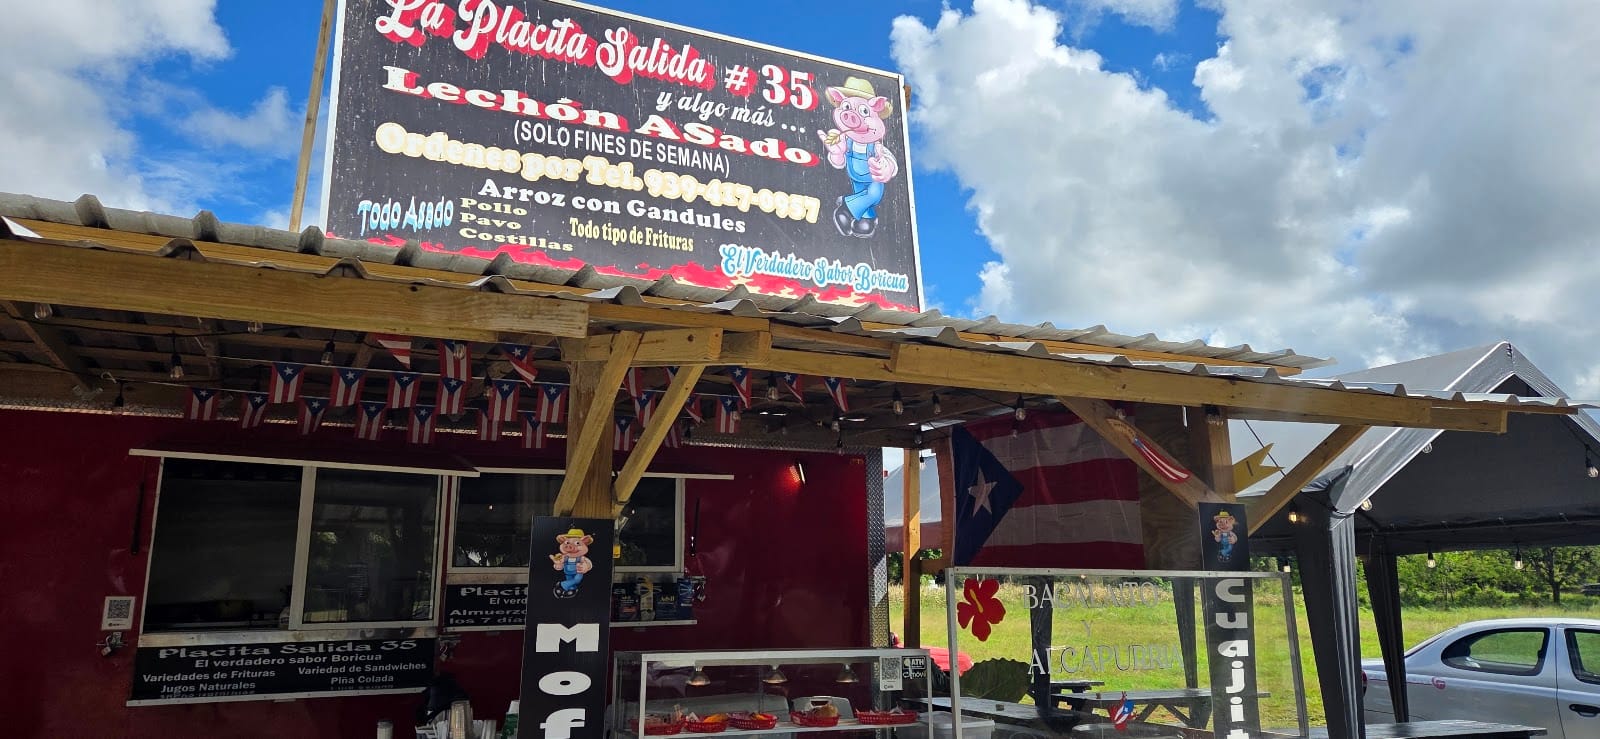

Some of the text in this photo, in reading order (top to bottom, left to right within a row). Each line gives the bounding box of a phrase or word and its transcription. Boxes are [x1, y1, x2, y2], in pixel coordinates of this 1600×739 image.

[376, 0, 813, 110] La Placita Salida # 35
[382, 65, 621, 130] Lechón
[656, 91, 672, 111] y
[677, 92, 729, 121] algo
[731, 105, 775, 127] más
[514, 119, 730, 178] (SOLO FINES DE SEMANA)
[375, 122, 821, 223] Ordenes por Tel. 939-417-0957
[357, 195, 454, 236] Todo Asado
[460, 198, 528, 216] Pollo
[478, 178, 746, 233] Arroz con Gandules
[460, 212, 522, 230] Pavo
[459, 228, 574, 252] Costillas
[569, 217, 694, 252] Todo tipo de Frituras
[719, 244, 909, 293] El Verdadero Sabor Boricua
[489, 597, 499, 605] El
[449, 617, 475, 625] los
[159, 640, 417, 659] Placita Salida 35
[195, 652, 383, 668] El verdadero sabor Boricua
[142, 669, 276, 682] Variedades de Frituras
[298, 660, 427, 675] Variedad de Sandwiches
[160, 680, 256, 694] Jugos Naturales
[331, 674, 394, 685] Piña Colada
